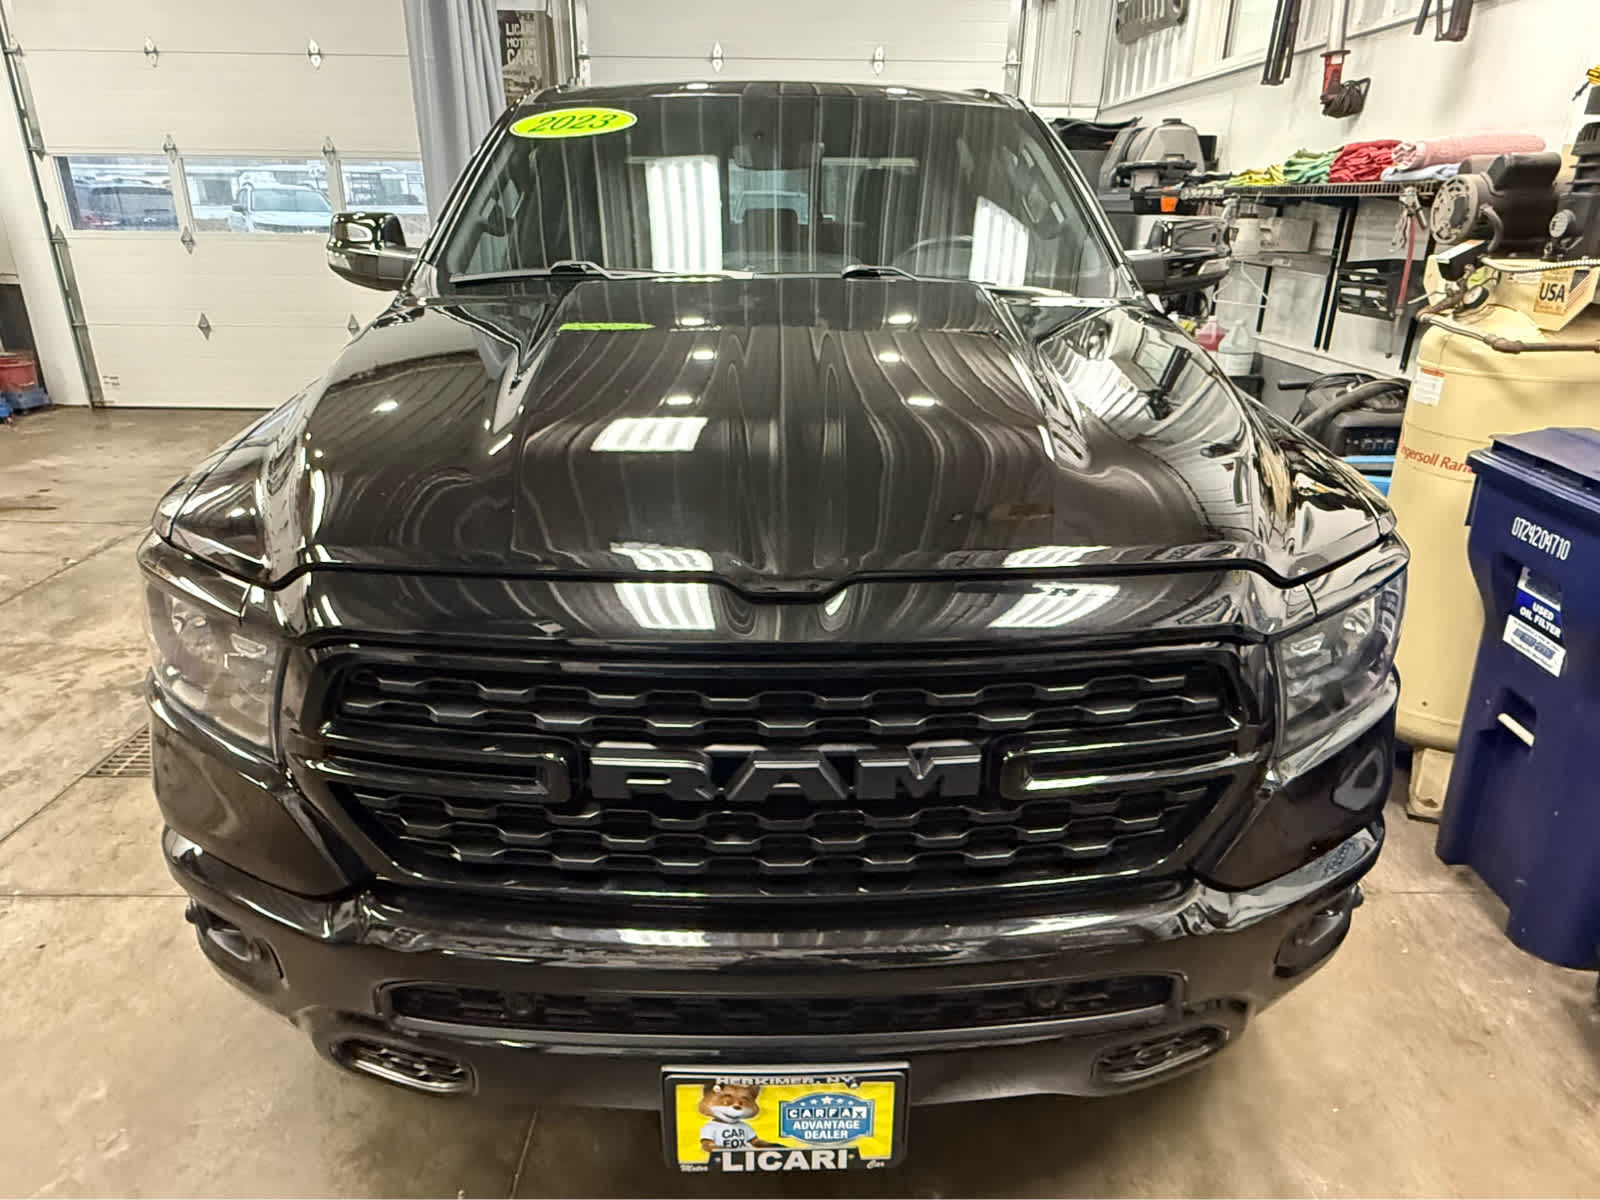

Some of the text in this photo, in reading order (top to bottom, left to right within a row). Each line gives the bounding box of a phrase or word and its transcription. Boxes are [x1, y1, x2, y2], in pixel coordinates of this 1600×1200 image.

[527, 114, 619, 133] 2023
[1539, 282, 1566, 303] USA
[1532, 602, 1555, 622] USED
[1519, 606, 1534, 621] OIL
[1533, 614, 1562, 639] FILTER
[590, 741, 983, 801] RAM
[787, 1105, 867, 1119] CARFAX
[722, 1129, 746, 1140] CAR
[793, 1119, 861, 1131] ADVANTAGE
[723, 1140, 746, 1149] FOX
[804, 1130, 849, 1141] DEALER
[721, 1150, 849, 1172] LICARI
